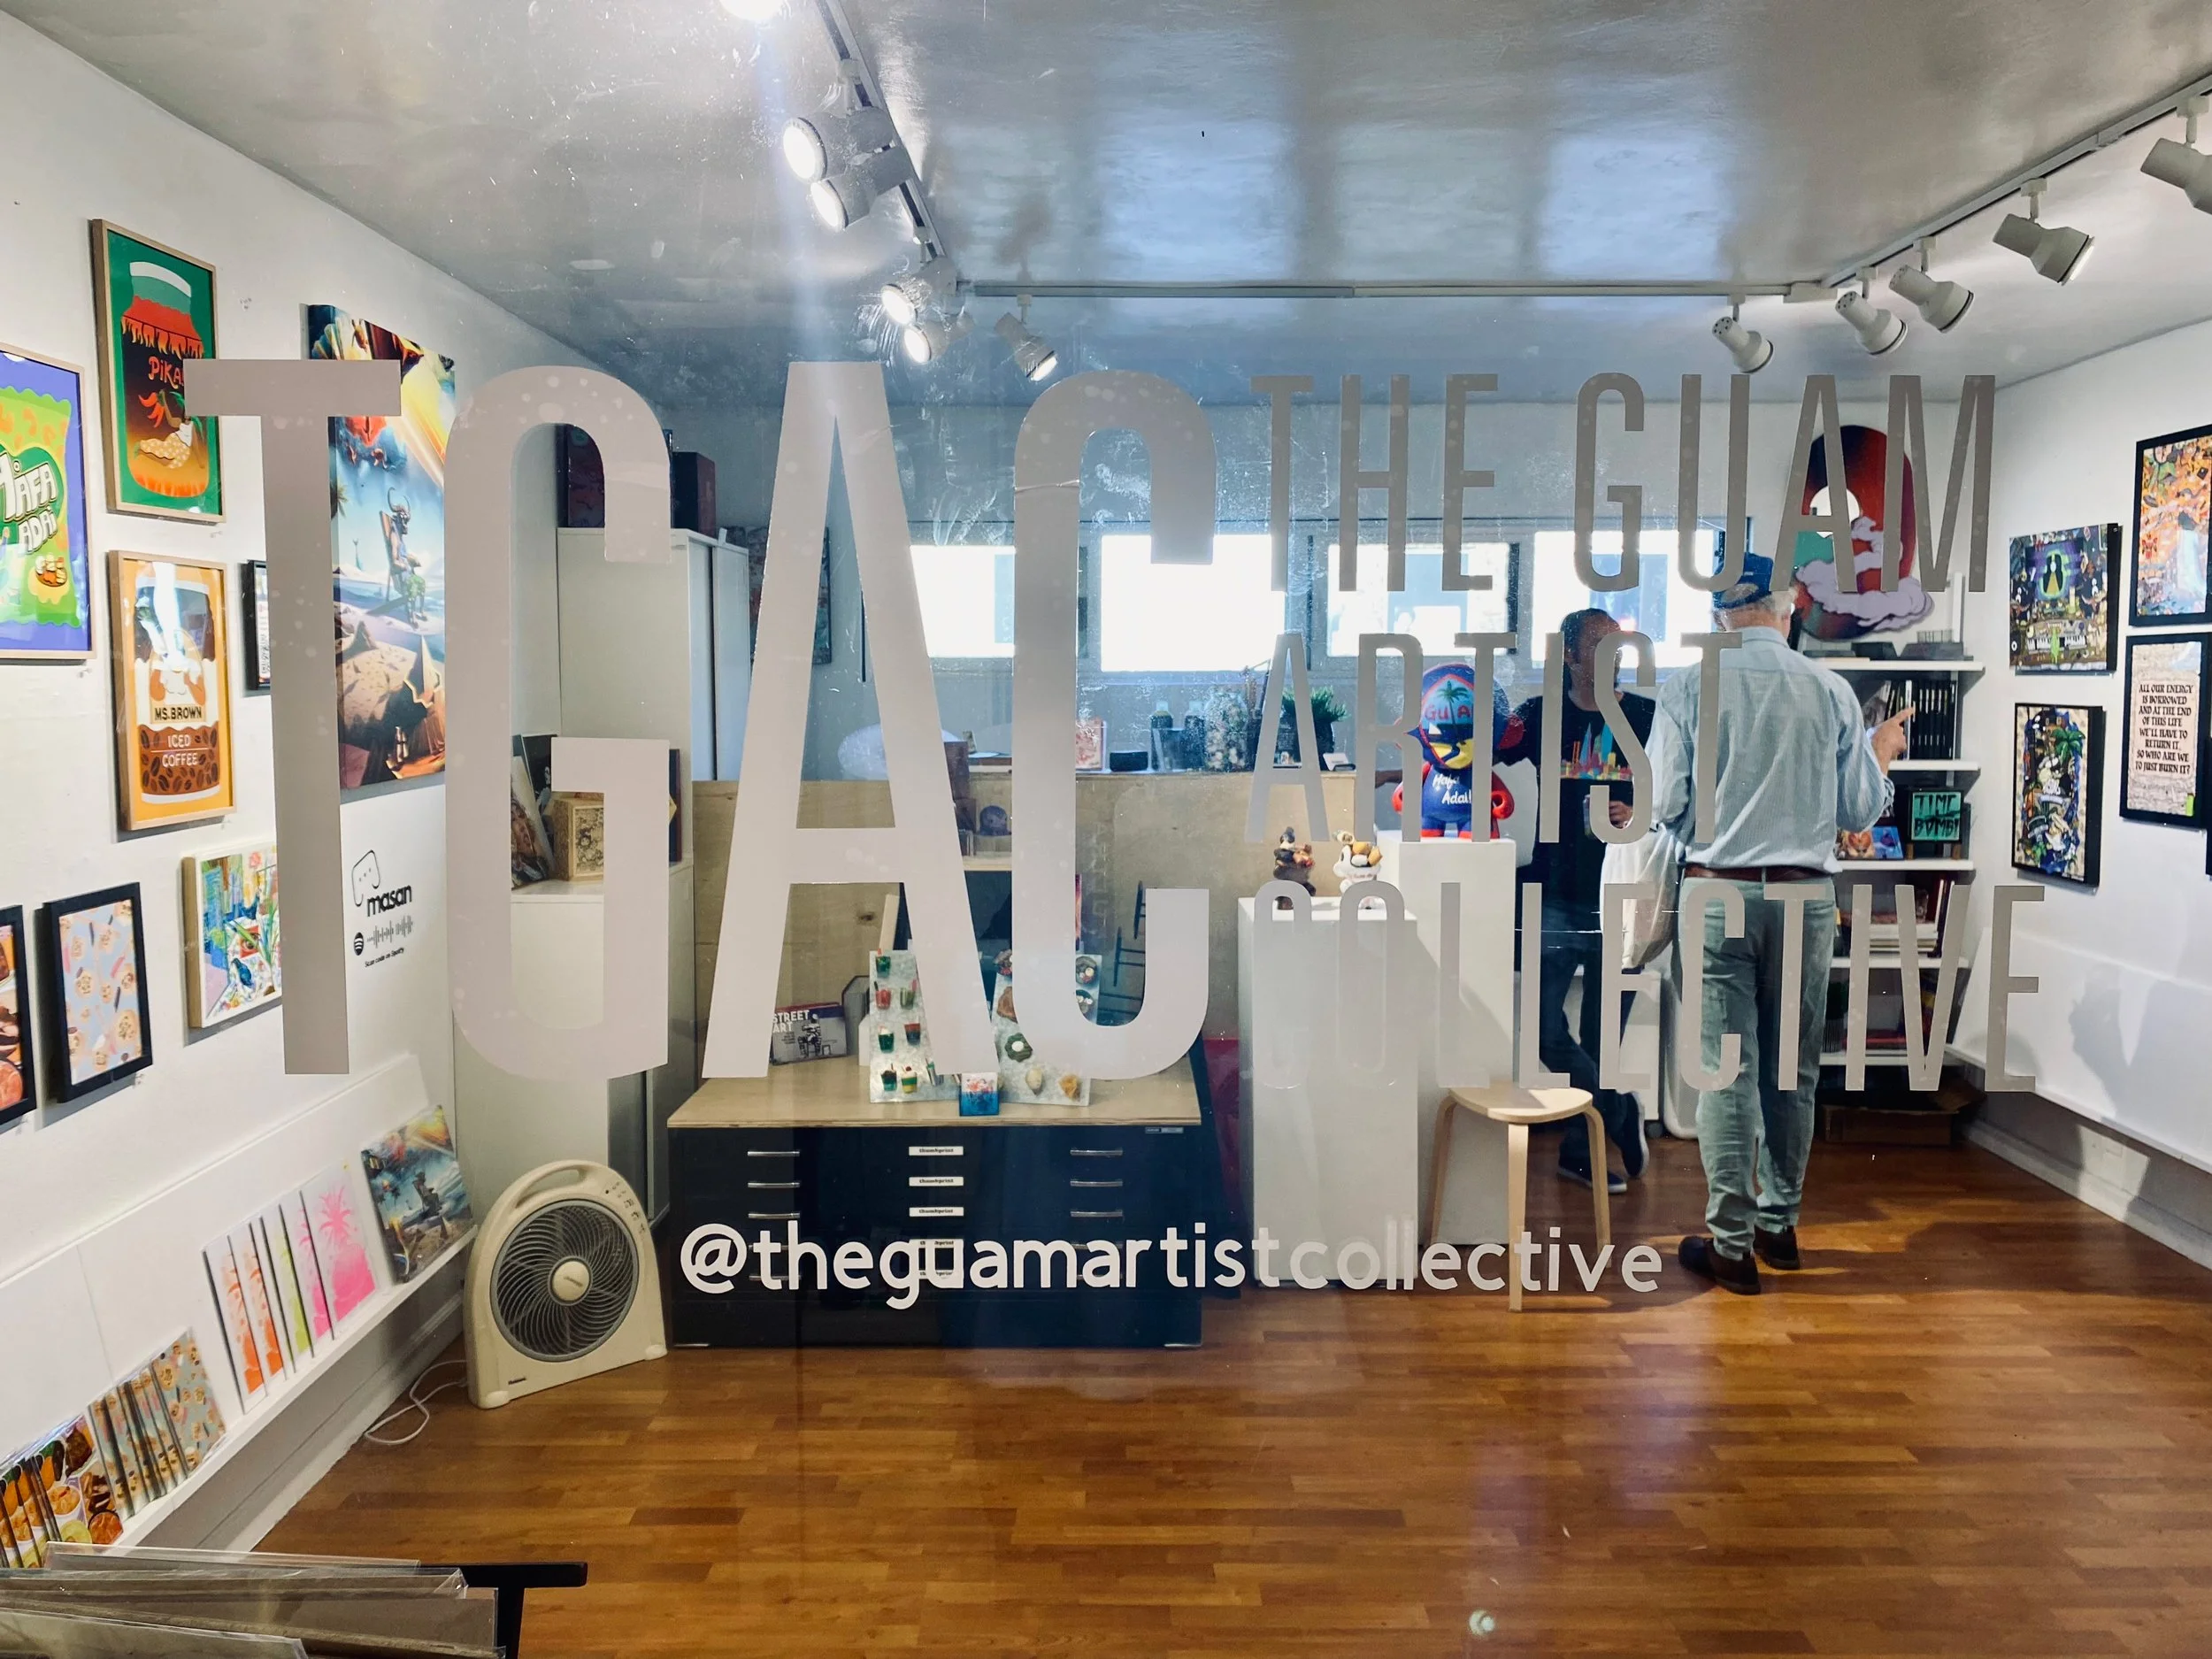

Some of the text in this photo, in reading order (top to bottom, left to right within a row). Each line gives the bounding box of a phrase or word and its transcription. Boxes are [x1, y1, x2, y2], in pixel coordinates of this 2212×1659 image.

[1251, 373, 1996, 593] THE GUAM
[2139, 684, 2193, 694] ALL OUR ENERGY
[2149, 695, 2187, 704] BORROWED
[1425, 703, 1471, 720] GUA
[2139, 705, 2192, 716] AND AT THE END
[184, 359, 1217, 1079] TGAC
[2142, 716, 2182, 727] OF THIS LIFE
[167, 733, 191, 748] ICED
[1246, 631, 1743, 844] ARTIST
[2159, 729, 2177, 738] HAVE
[2179, 730, 2188, 739] TO
[2145, 739, 2170, 749] RETURN
[161, 752, 198, 768] COFFEE
[2137, 749, 2189, 762] SO WHO ARE WE
[2135, 761, 2142, 770] TO
[2143, 762, 2157, 772] JUST
[2159, 763, 2177, 772] BURN
[366, 884, 412, 918] masan
[1251, 879, 2045, 1093] COLLECTIVE
[772, 1010, 810, 1024] STREET
[772, 1021, 794, 1033] ART
[680, 1219, 1663, 1310] @theguamartistcollective
